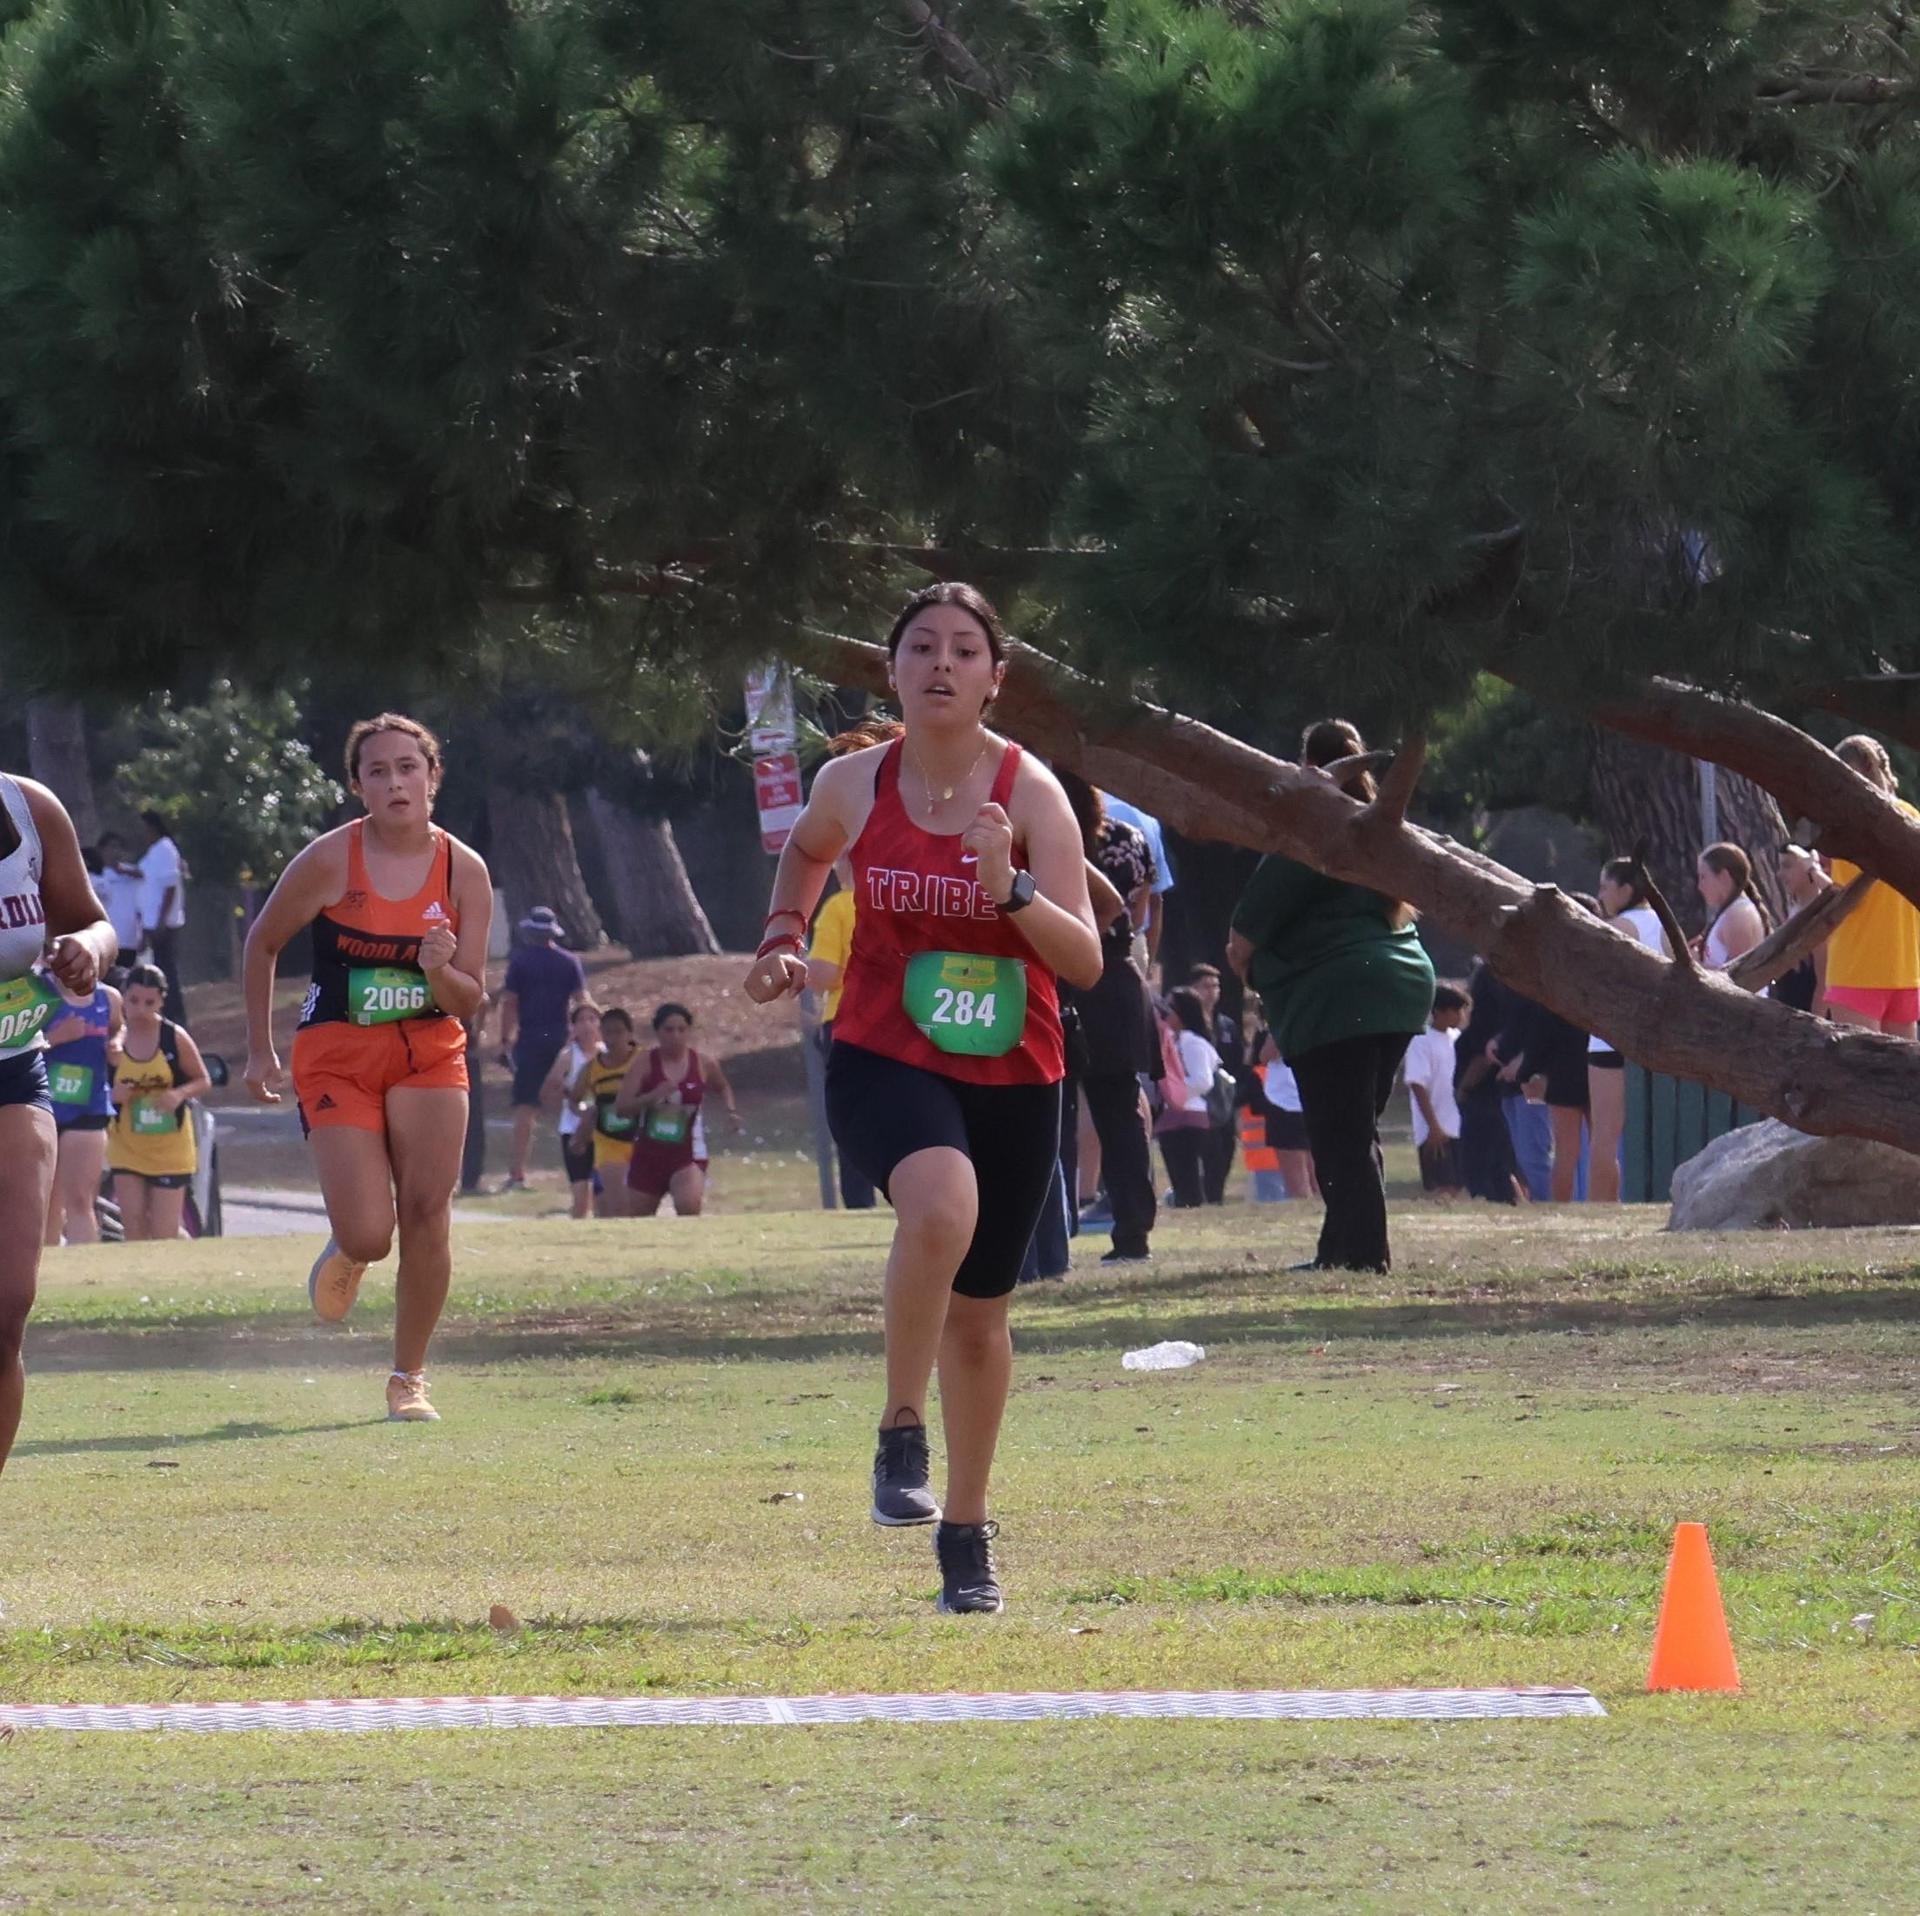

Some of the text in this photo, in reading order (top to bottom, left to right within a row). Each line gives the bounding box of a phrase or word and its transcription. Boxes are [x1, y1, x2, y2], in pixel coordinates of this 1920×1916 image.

[0, 894, 45, 929] DI
[867, 867, 999, 920] TRIBE
[363, 987, 425, 1011] 2066
[932, 988, 996, 1027] 284
